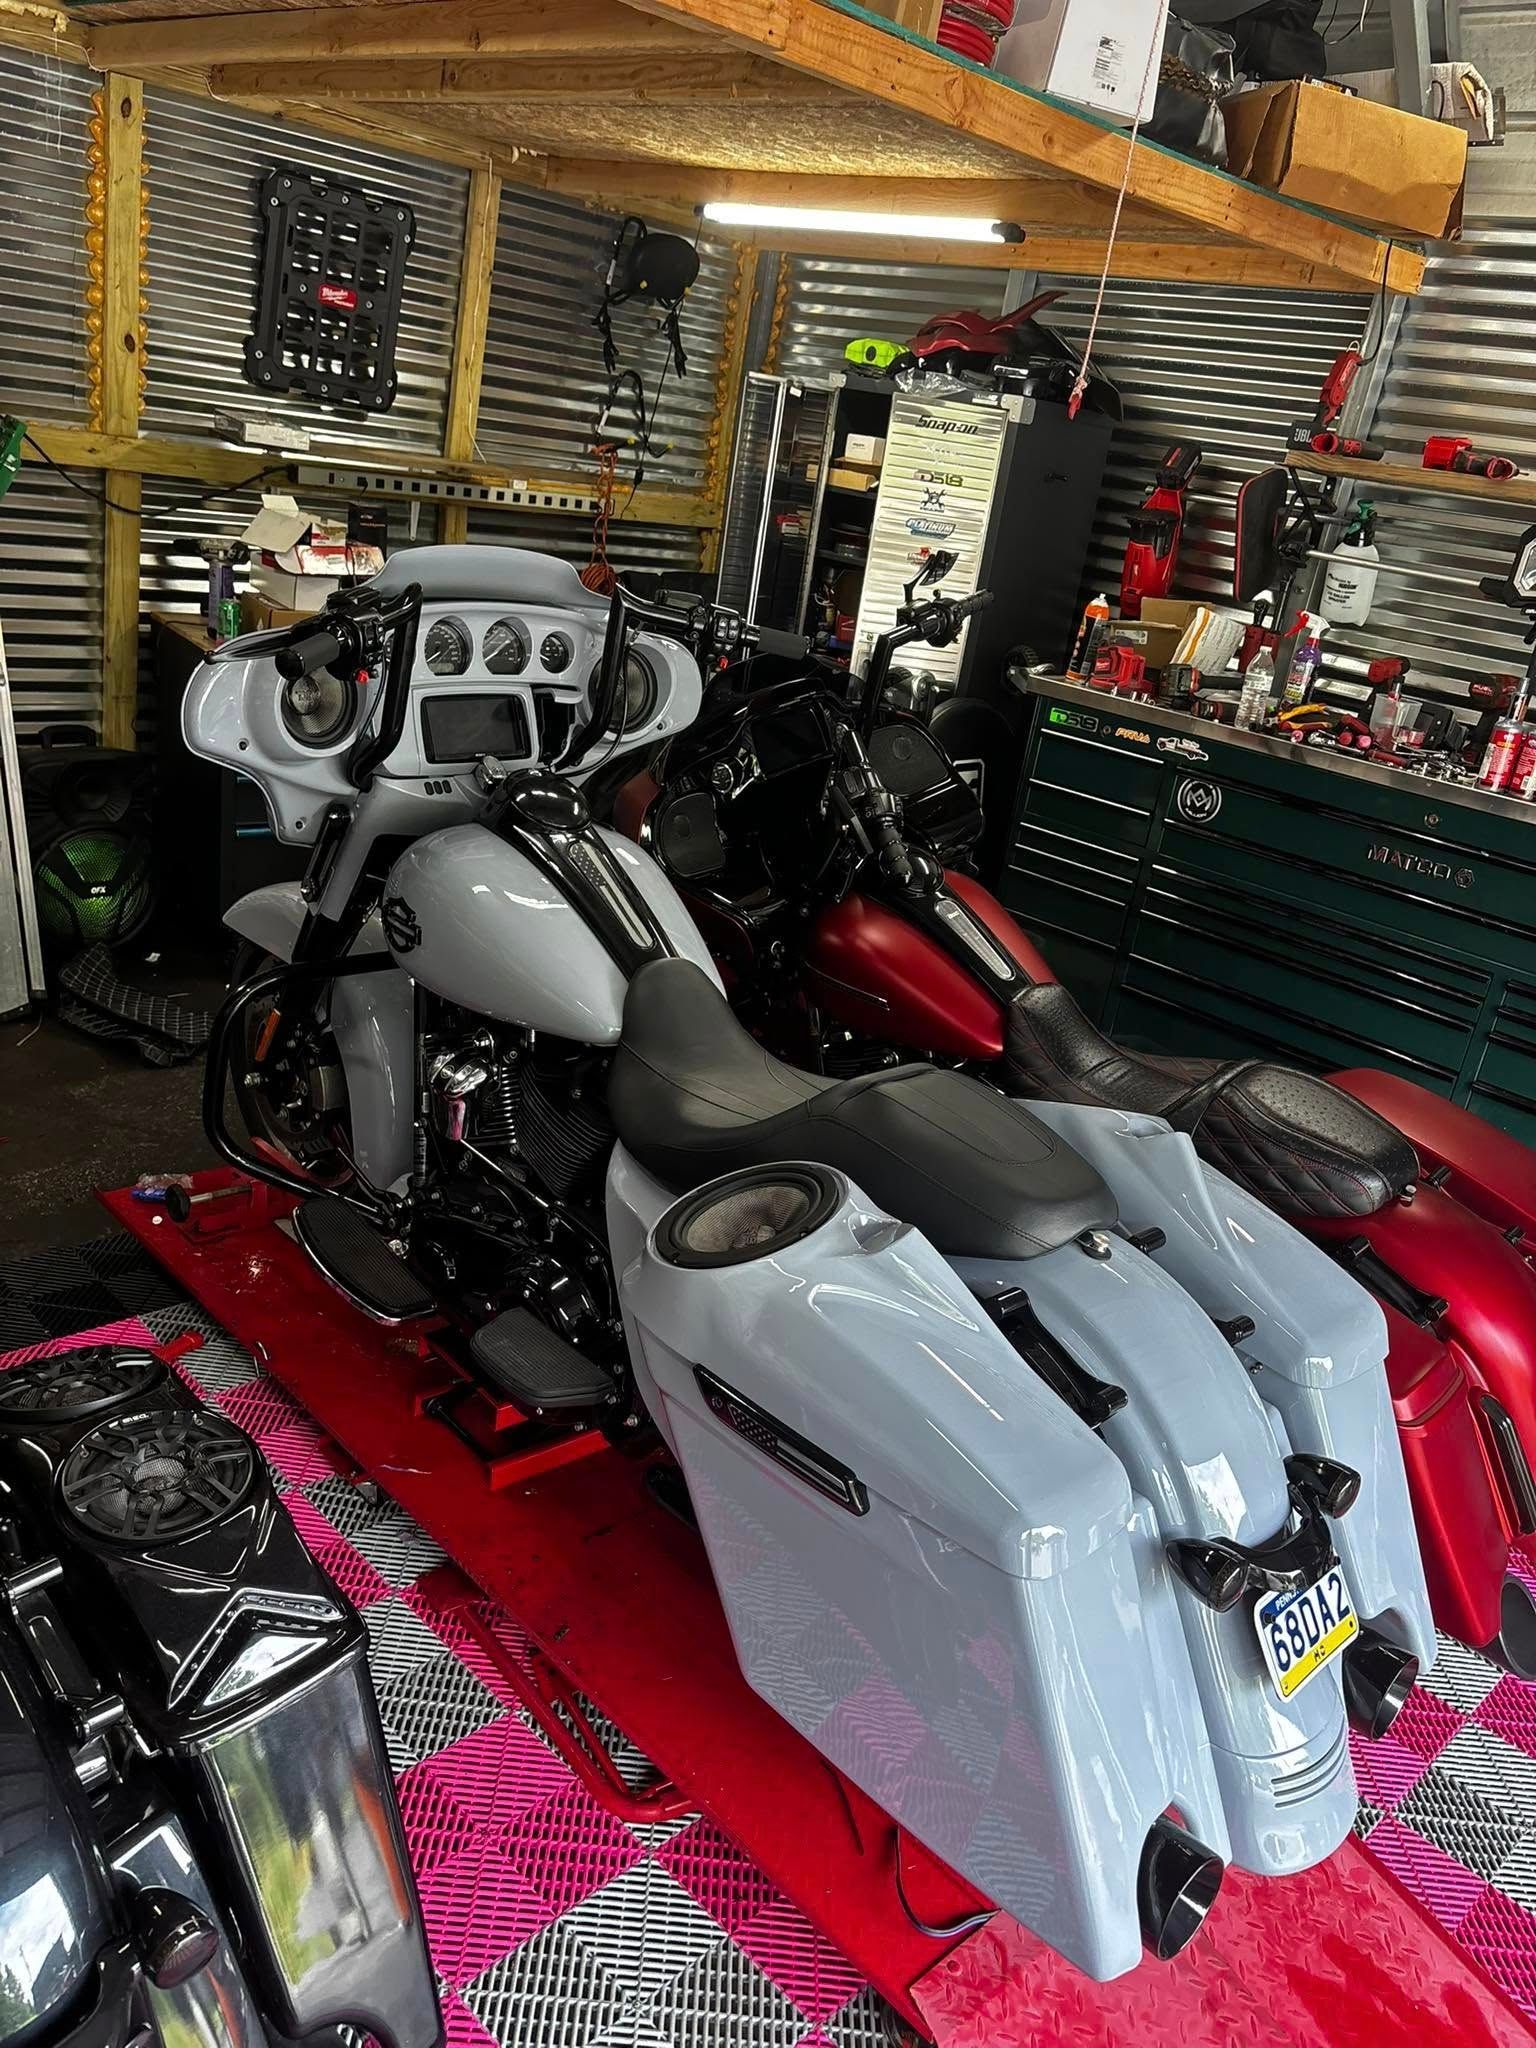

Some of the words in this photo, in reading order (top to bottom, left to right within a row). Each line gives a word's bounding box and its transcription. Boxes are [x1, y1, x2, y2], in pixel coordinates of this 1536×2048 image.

[915, 414, 979, 435] Snap-on
[1294, 428, 1312, 442] JBL
[1367, 845, 1451, 881] MATCO
[1271, 1572, 1350, 1672] 68DA2
